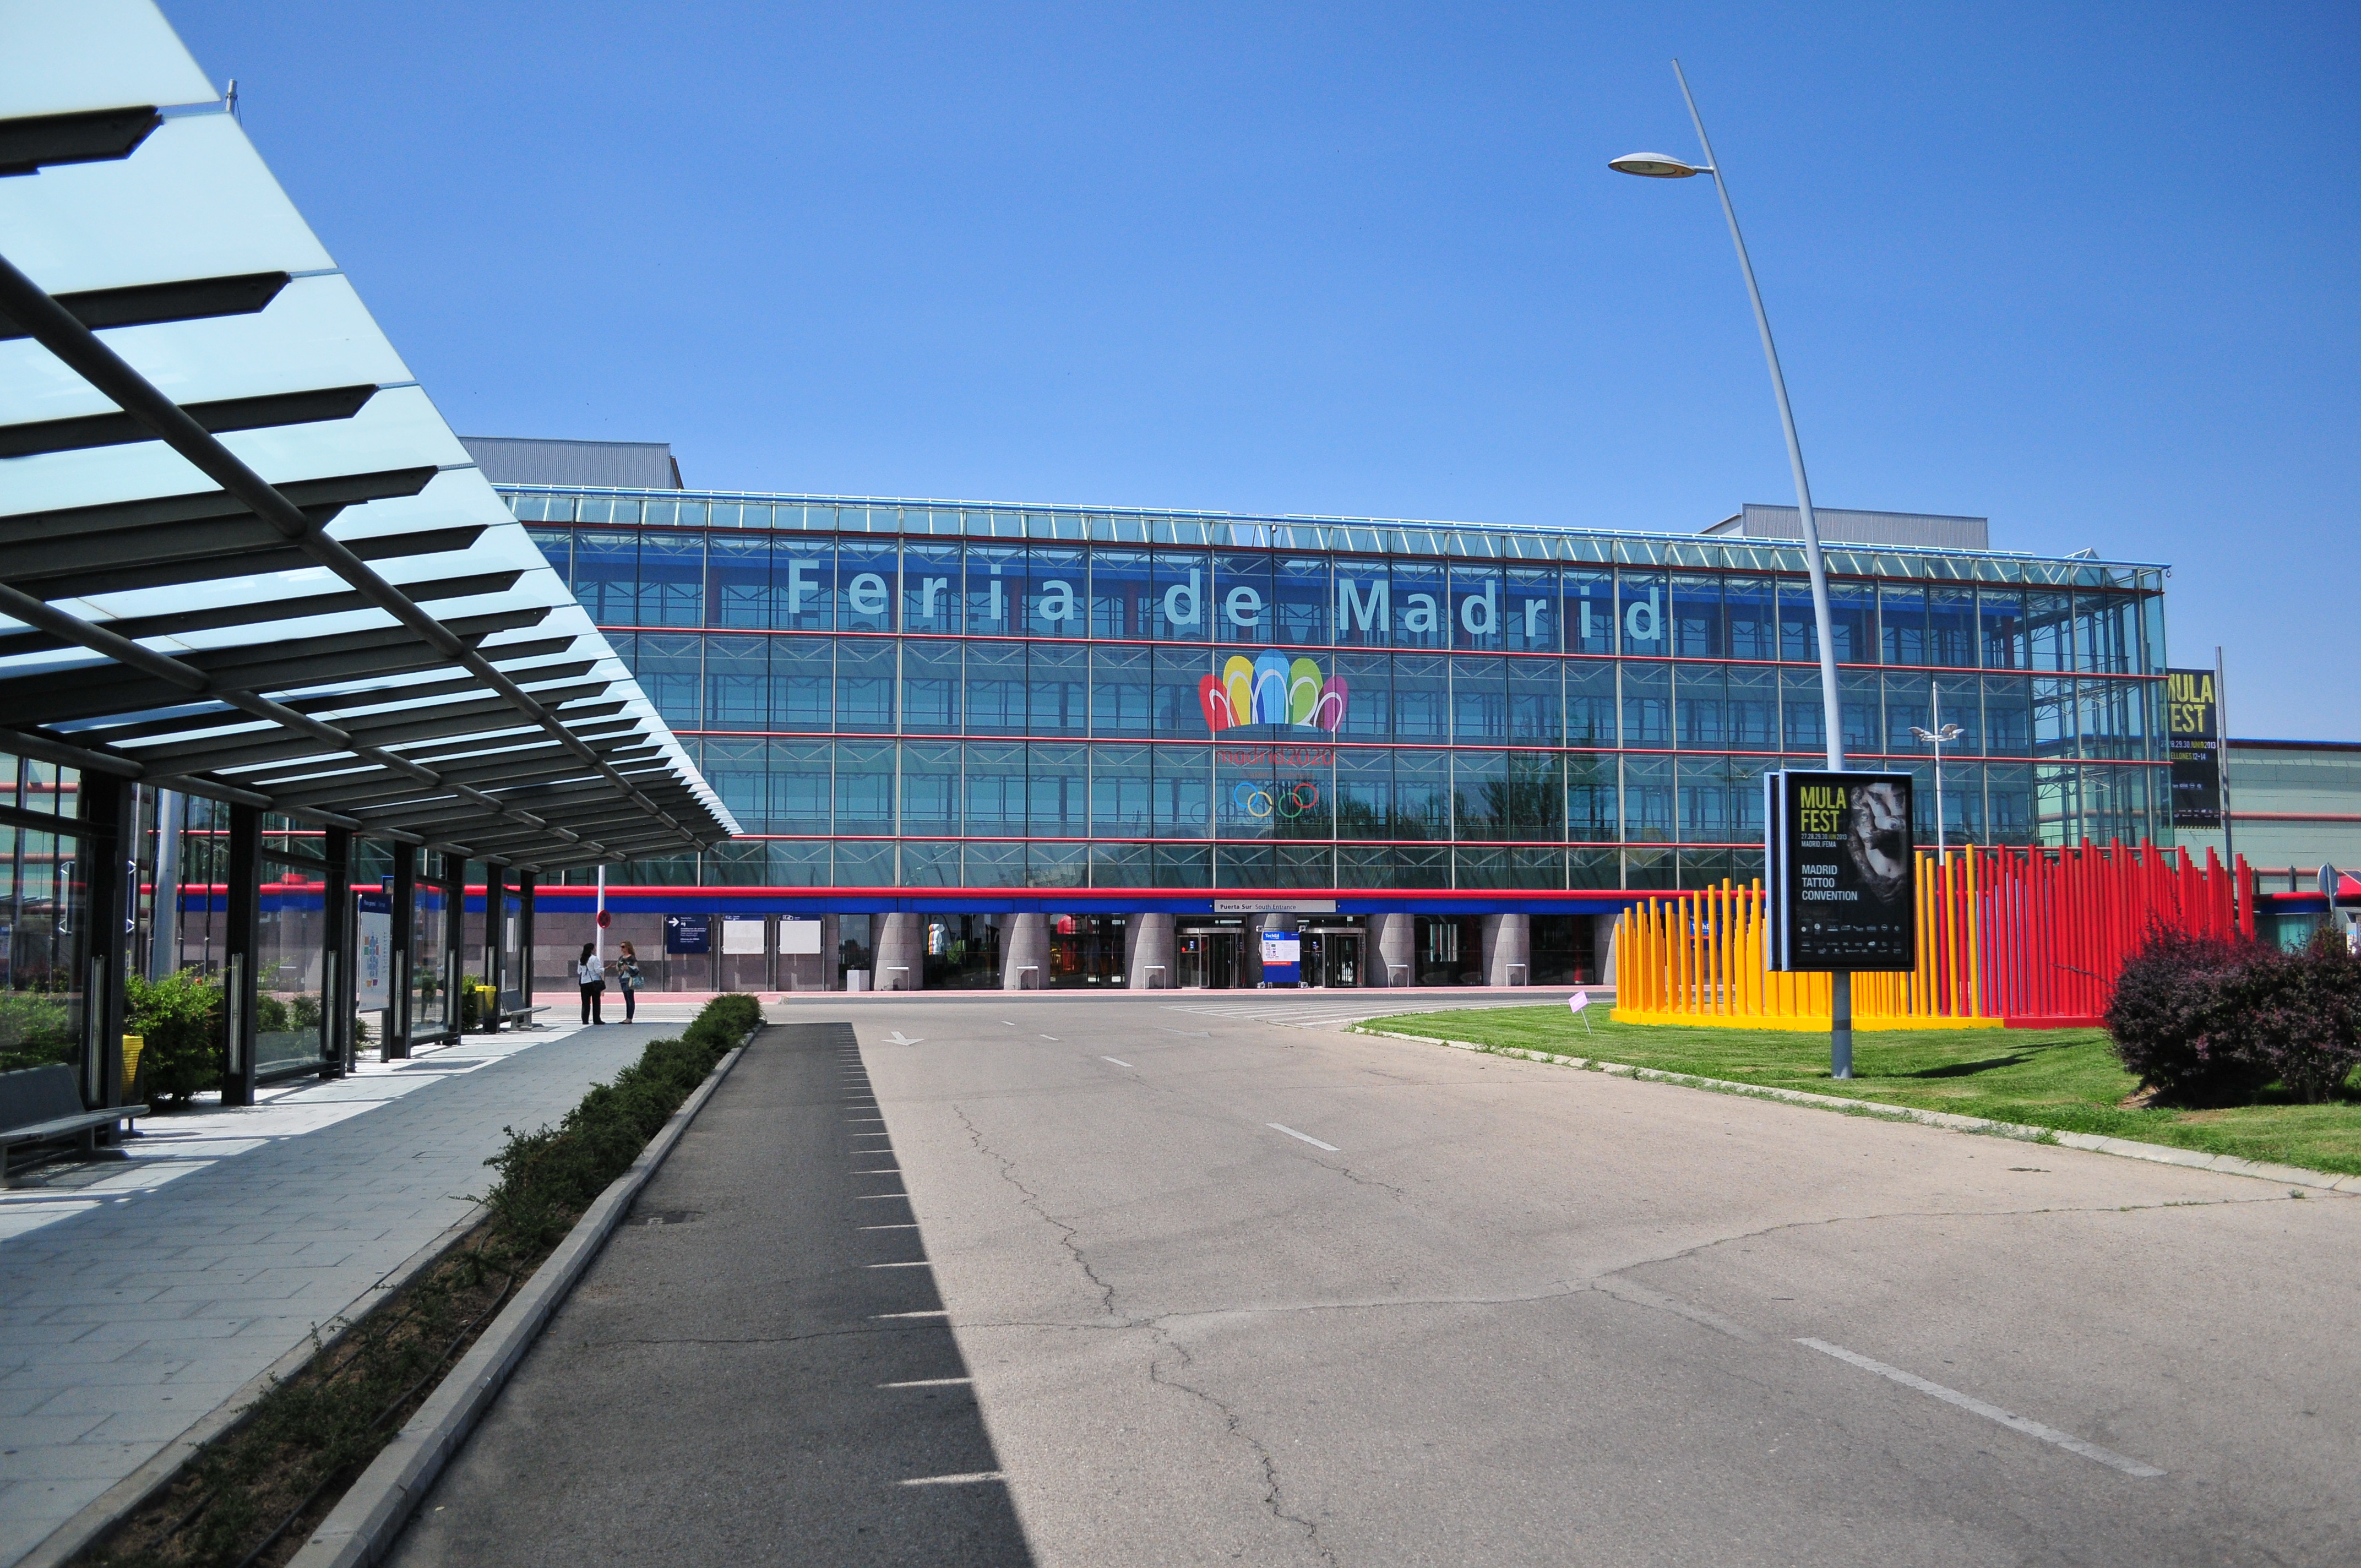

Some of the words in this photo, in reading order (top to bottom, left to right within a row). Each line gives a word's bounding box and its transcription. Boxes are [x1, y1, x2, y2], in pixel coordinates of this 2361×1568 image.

[788, 559, 1075, 621] Feria
[1163, 568, 1261, 627] de
[1338, 579, 1661, 640] Madrid
[1215, 745, 1334, 766] madrid2020
[1800, 786, 1847, 809] MULA
[1801, 810, 1840, 832] FEST
[1802, 864, 1837, 875] MADRID
[1802, 878, 1835, 888] TATTOO
[1802, 890, 1857, 901] CONVENTION
